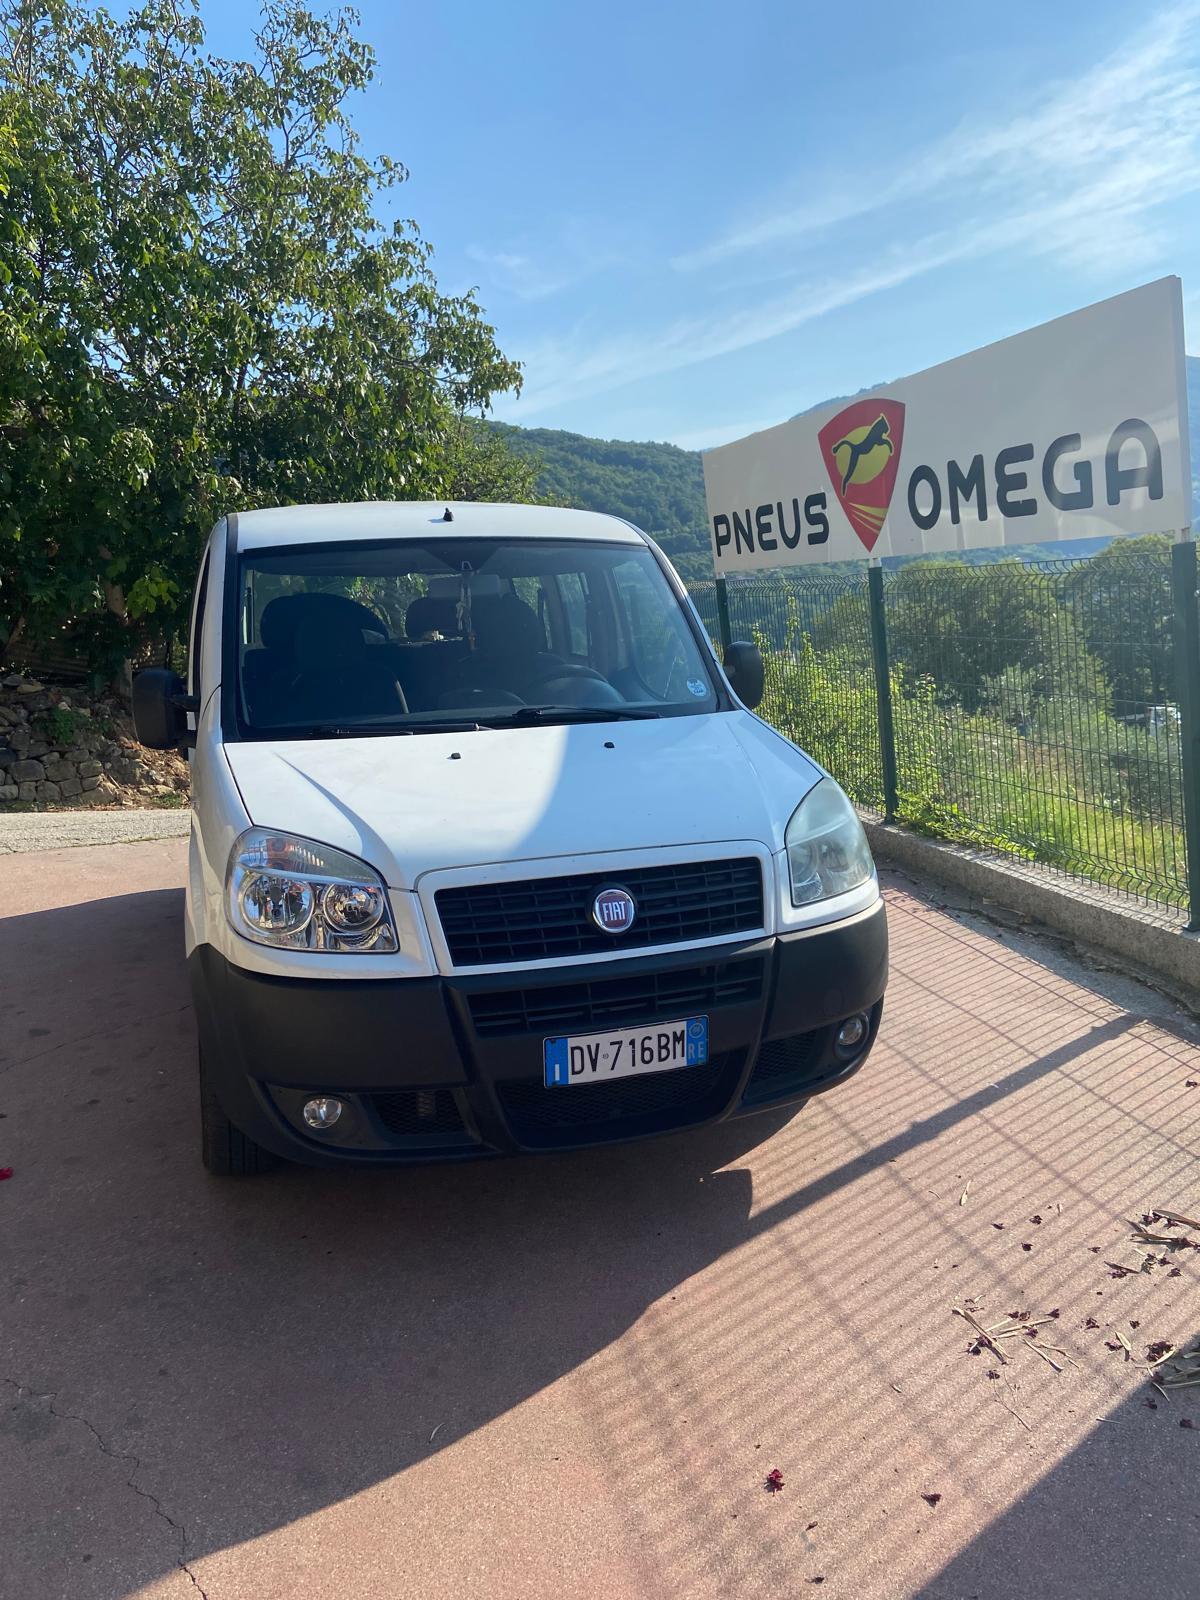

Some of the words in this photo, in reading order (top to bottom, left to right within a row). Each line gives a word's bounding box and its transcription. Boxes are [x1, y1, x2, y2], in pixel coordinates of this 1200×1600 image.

[713, 491, 830, 558] PNEUS
[907, 418, 1164, 531] OMEGA
[602, 901, 626, 922] FIAT
[688, 1041, 704, 1061] RE
